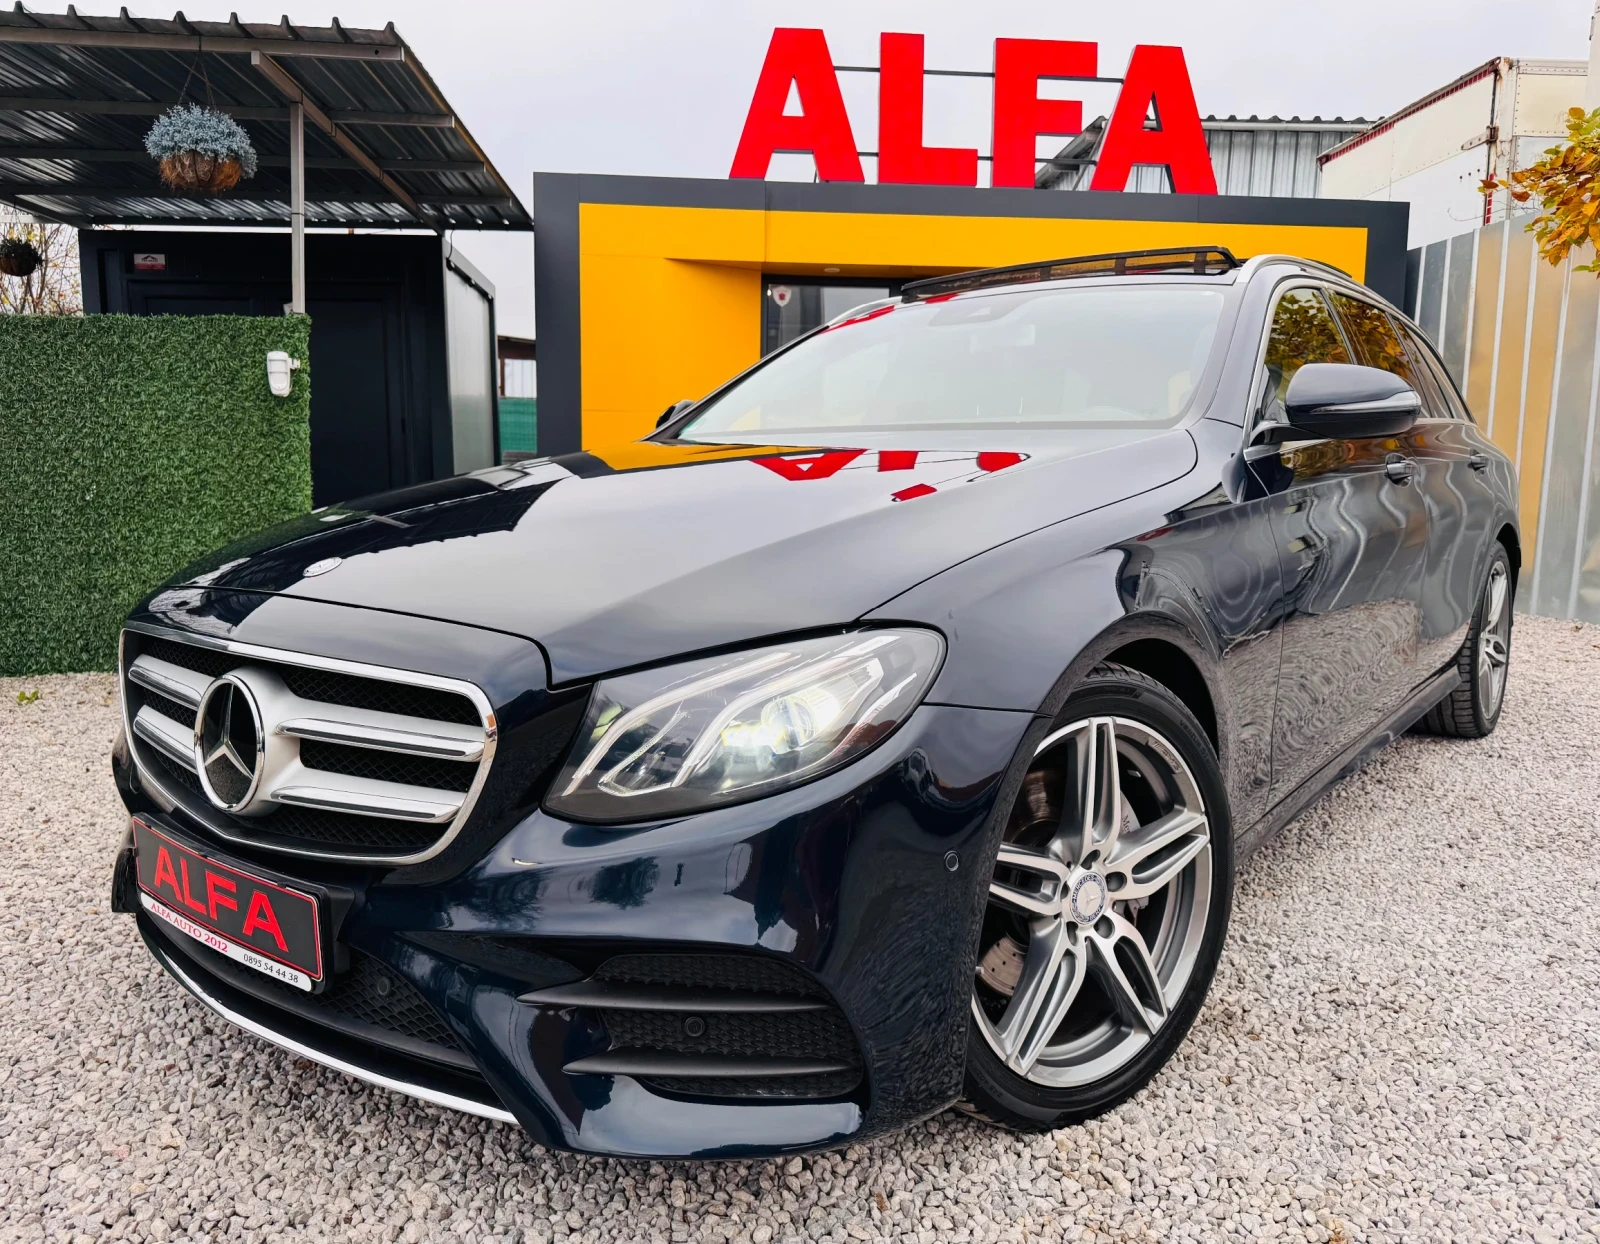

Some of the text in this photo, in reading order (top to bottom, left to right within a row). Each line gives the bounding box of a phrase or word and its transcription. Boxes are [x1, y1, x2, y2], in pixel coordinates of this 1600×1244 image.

[729, 27, 1219, 195] ALFA
[151, 902, 228, 953] ALFA AUTO 2012
[154, 846, 289, 952] ALFA
[243, 953, 299, 984] 0895 54 44 38
